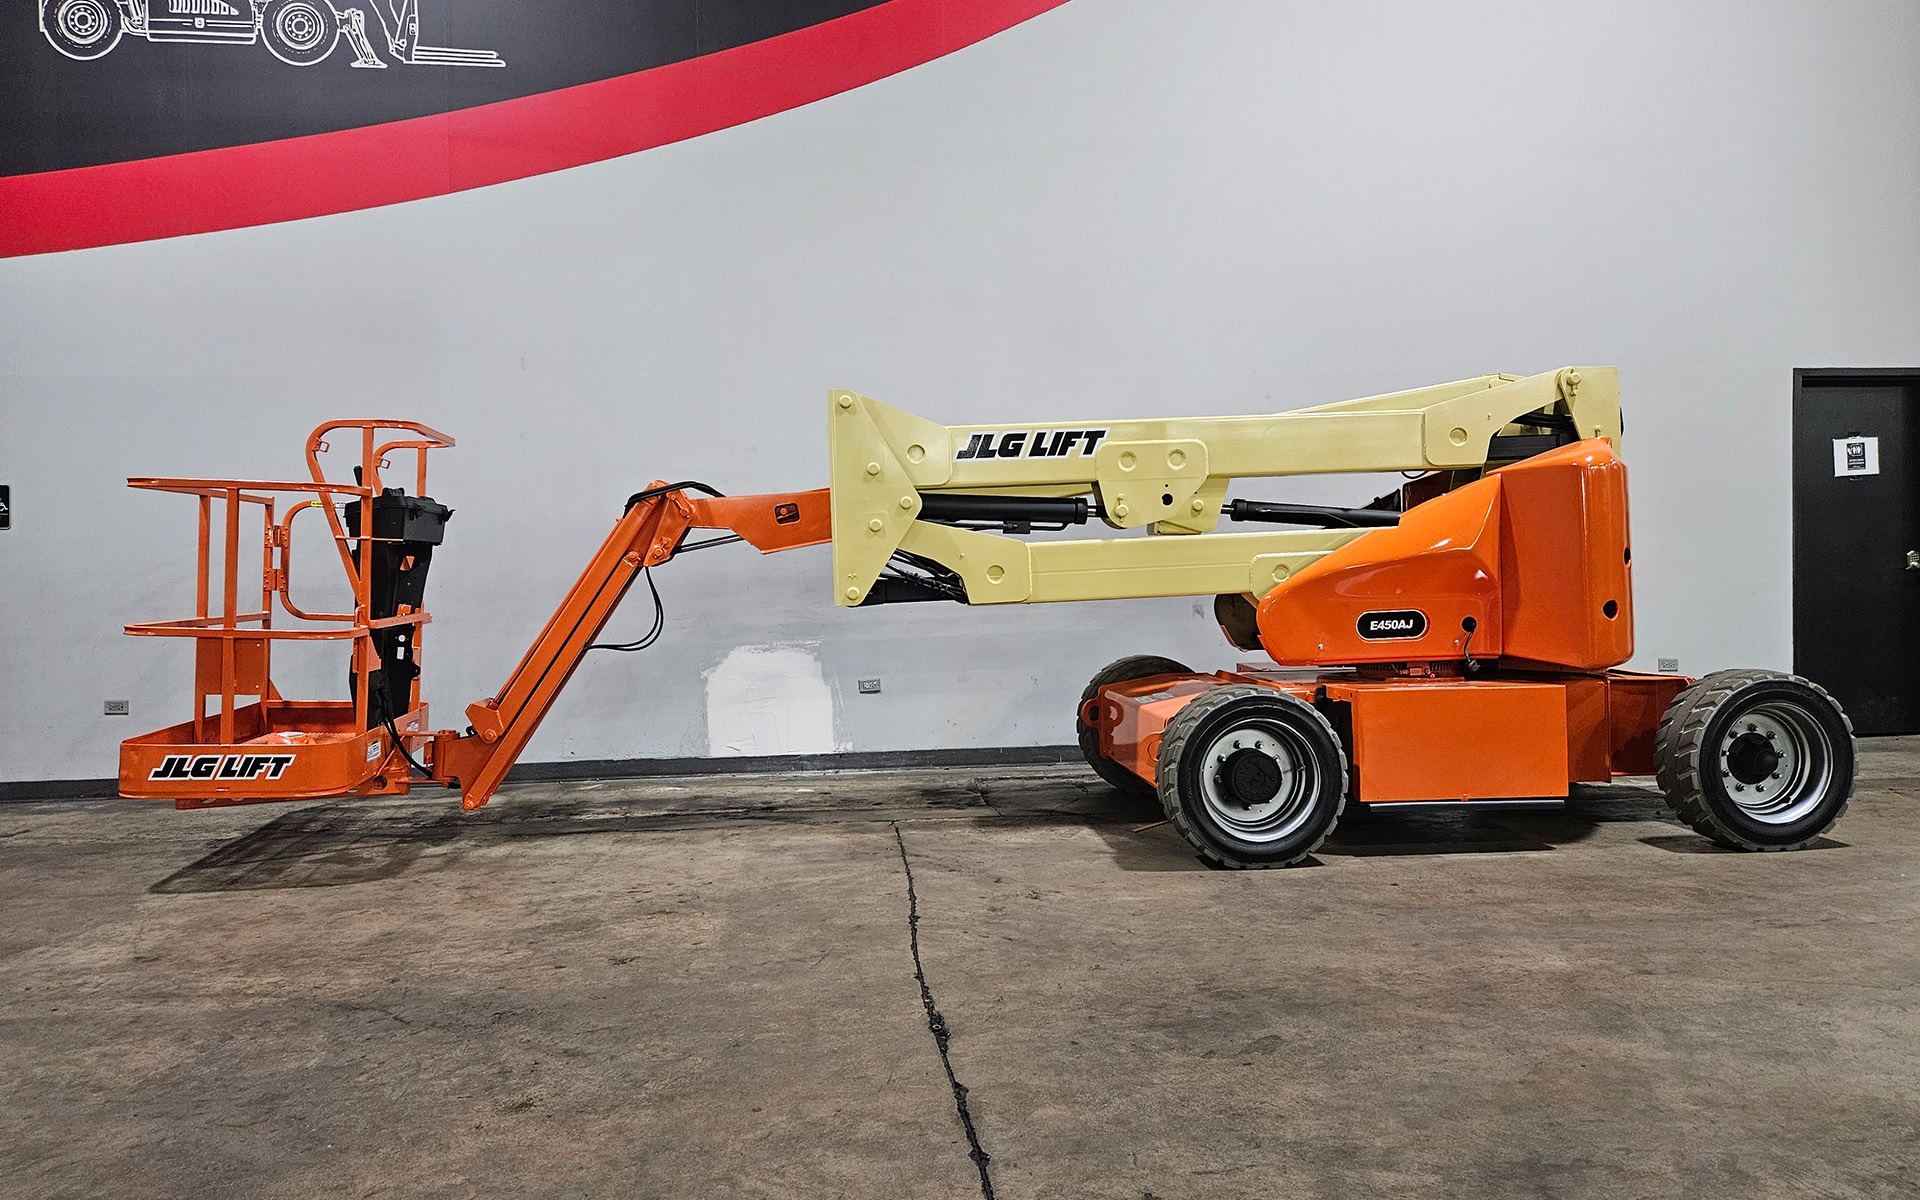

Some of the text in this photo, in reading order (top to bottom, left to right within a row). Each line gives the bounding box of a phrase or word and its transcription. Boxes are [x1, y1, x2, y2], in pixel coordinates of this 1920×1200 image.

[956, 430, 1107, 459] JLG LIFT
[1369, 619, 1414, 631] E450AJ
[151, 756, 293, 778] JLG LIFT
